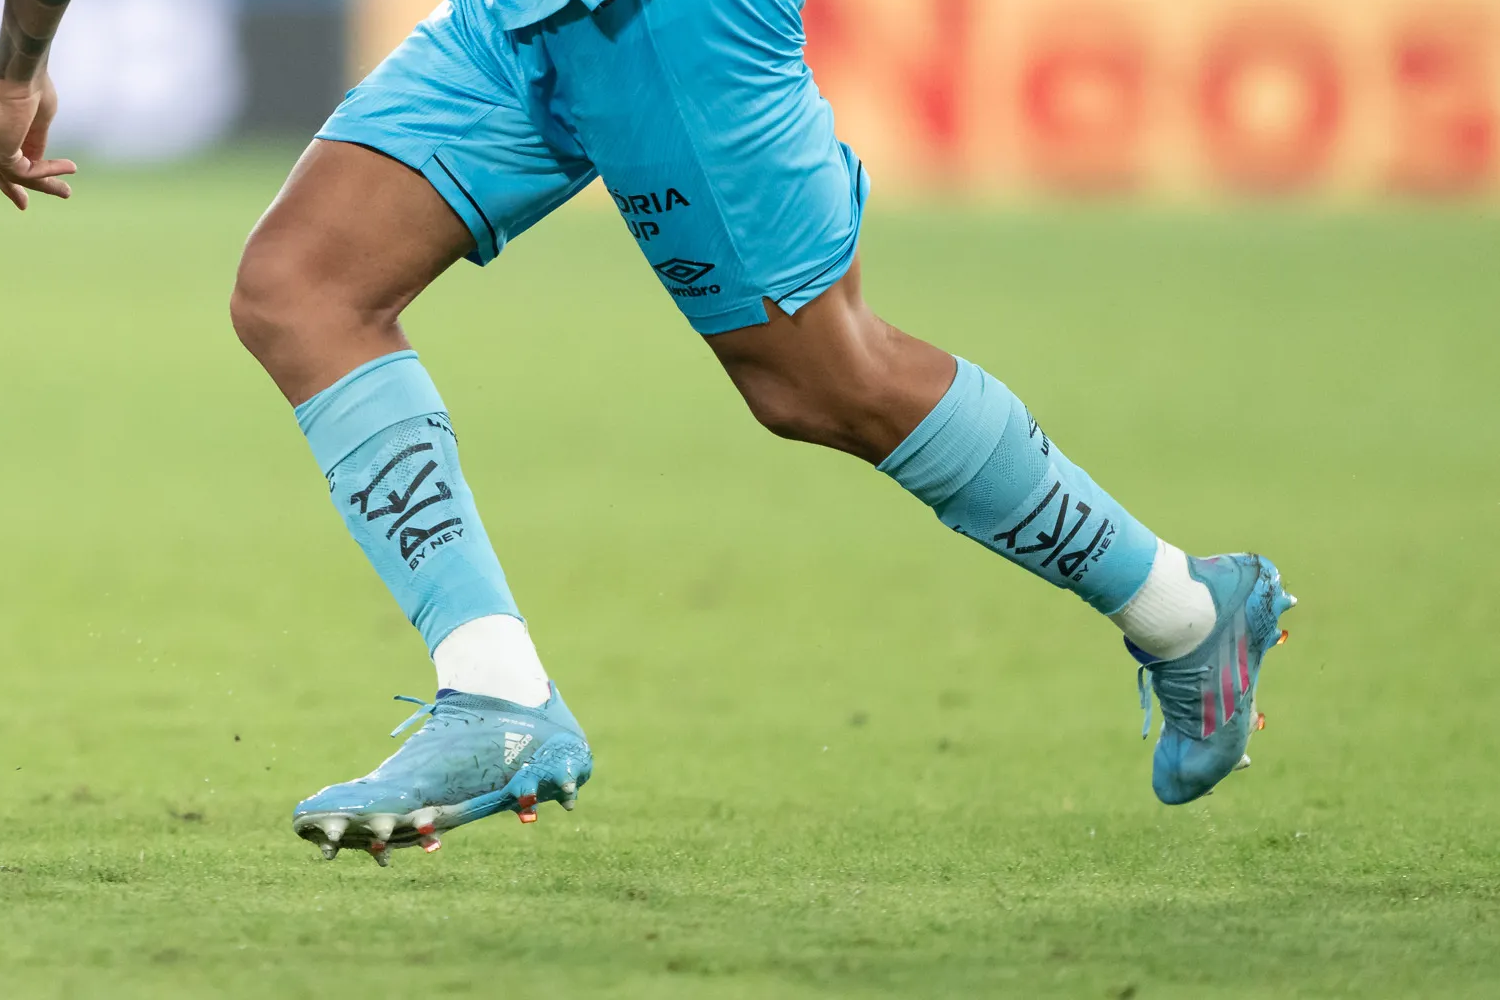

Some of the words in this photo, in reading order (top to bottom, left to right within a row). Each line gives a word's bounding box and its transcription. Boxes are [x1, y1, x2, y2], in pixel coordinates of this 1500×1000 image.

[608, 187, 691, 214] ÓRIA
[667, 284, 721, 298] mbro
[409, 547, 427, 571] BY
[429, 528, 465, 550] NEY
[1072, 563, 1090, 582] BY
[1090, 523, 1116, 562] NEY
[504, 733, 533, 765] adidas
